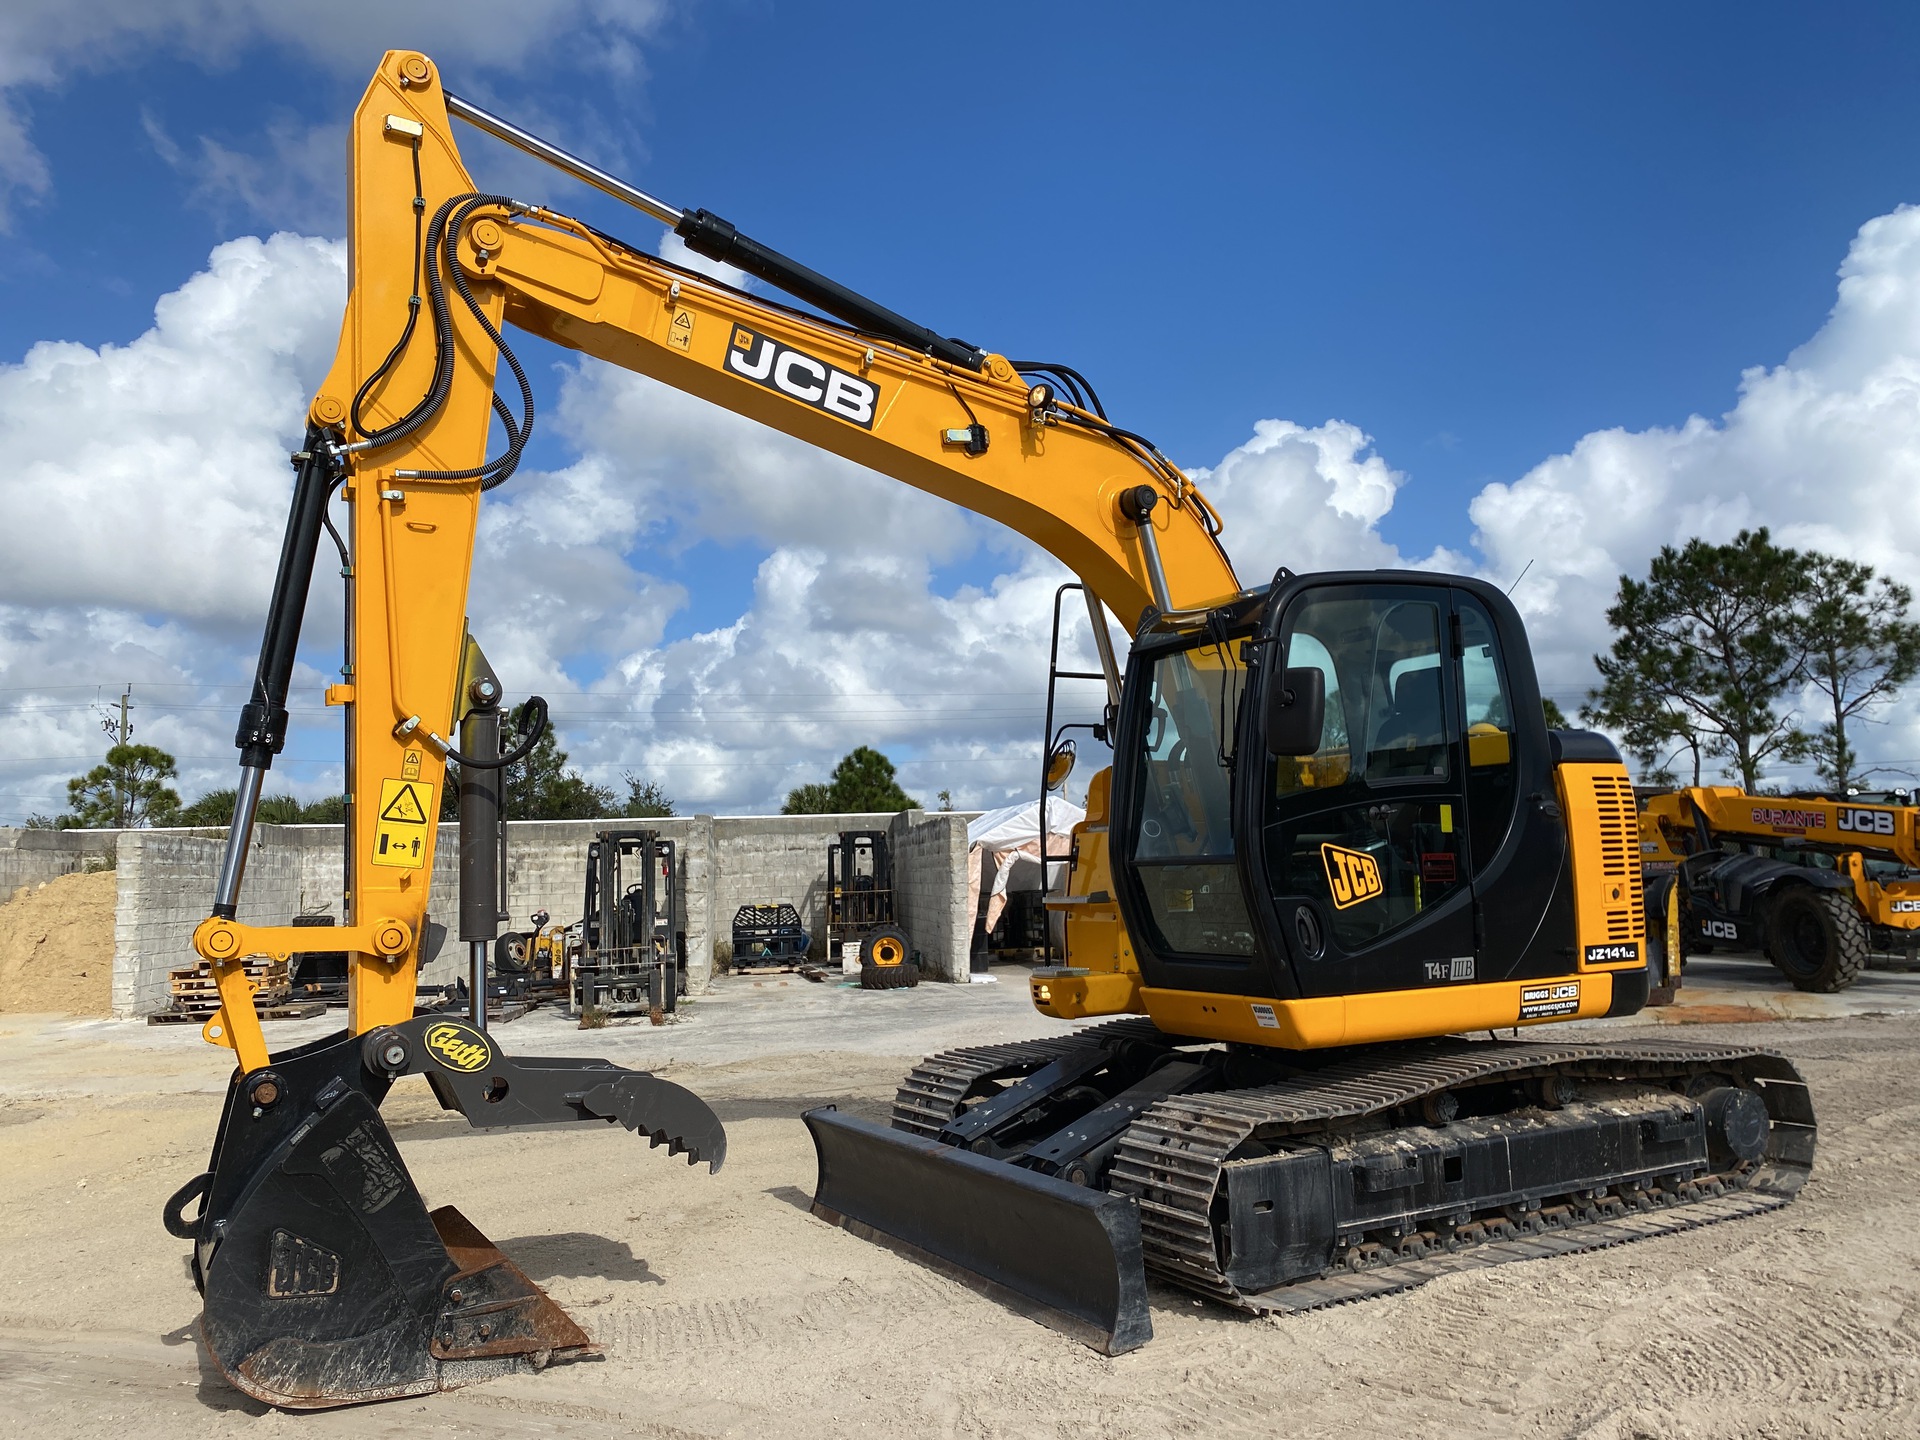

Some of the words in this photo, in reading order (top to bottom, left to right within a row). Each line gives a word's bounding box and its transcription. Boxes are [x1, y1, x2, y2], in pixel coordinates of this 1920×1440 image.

[730, 340, 874, 423] JCB
[1752, 808, 1826, 828] DURANTE
[1838, 809, 1894, 834] JCB
[1332, 851, 1379, 902] JCB
[1702, 920, 1738, 939] JCB
[554, 949, 562, 967] Yale
[1524, 990, 1549, 1000] BRIGGS
[1552, 986, 1577, 999] JCB
[275, 1234, 338, 1293] JCB
